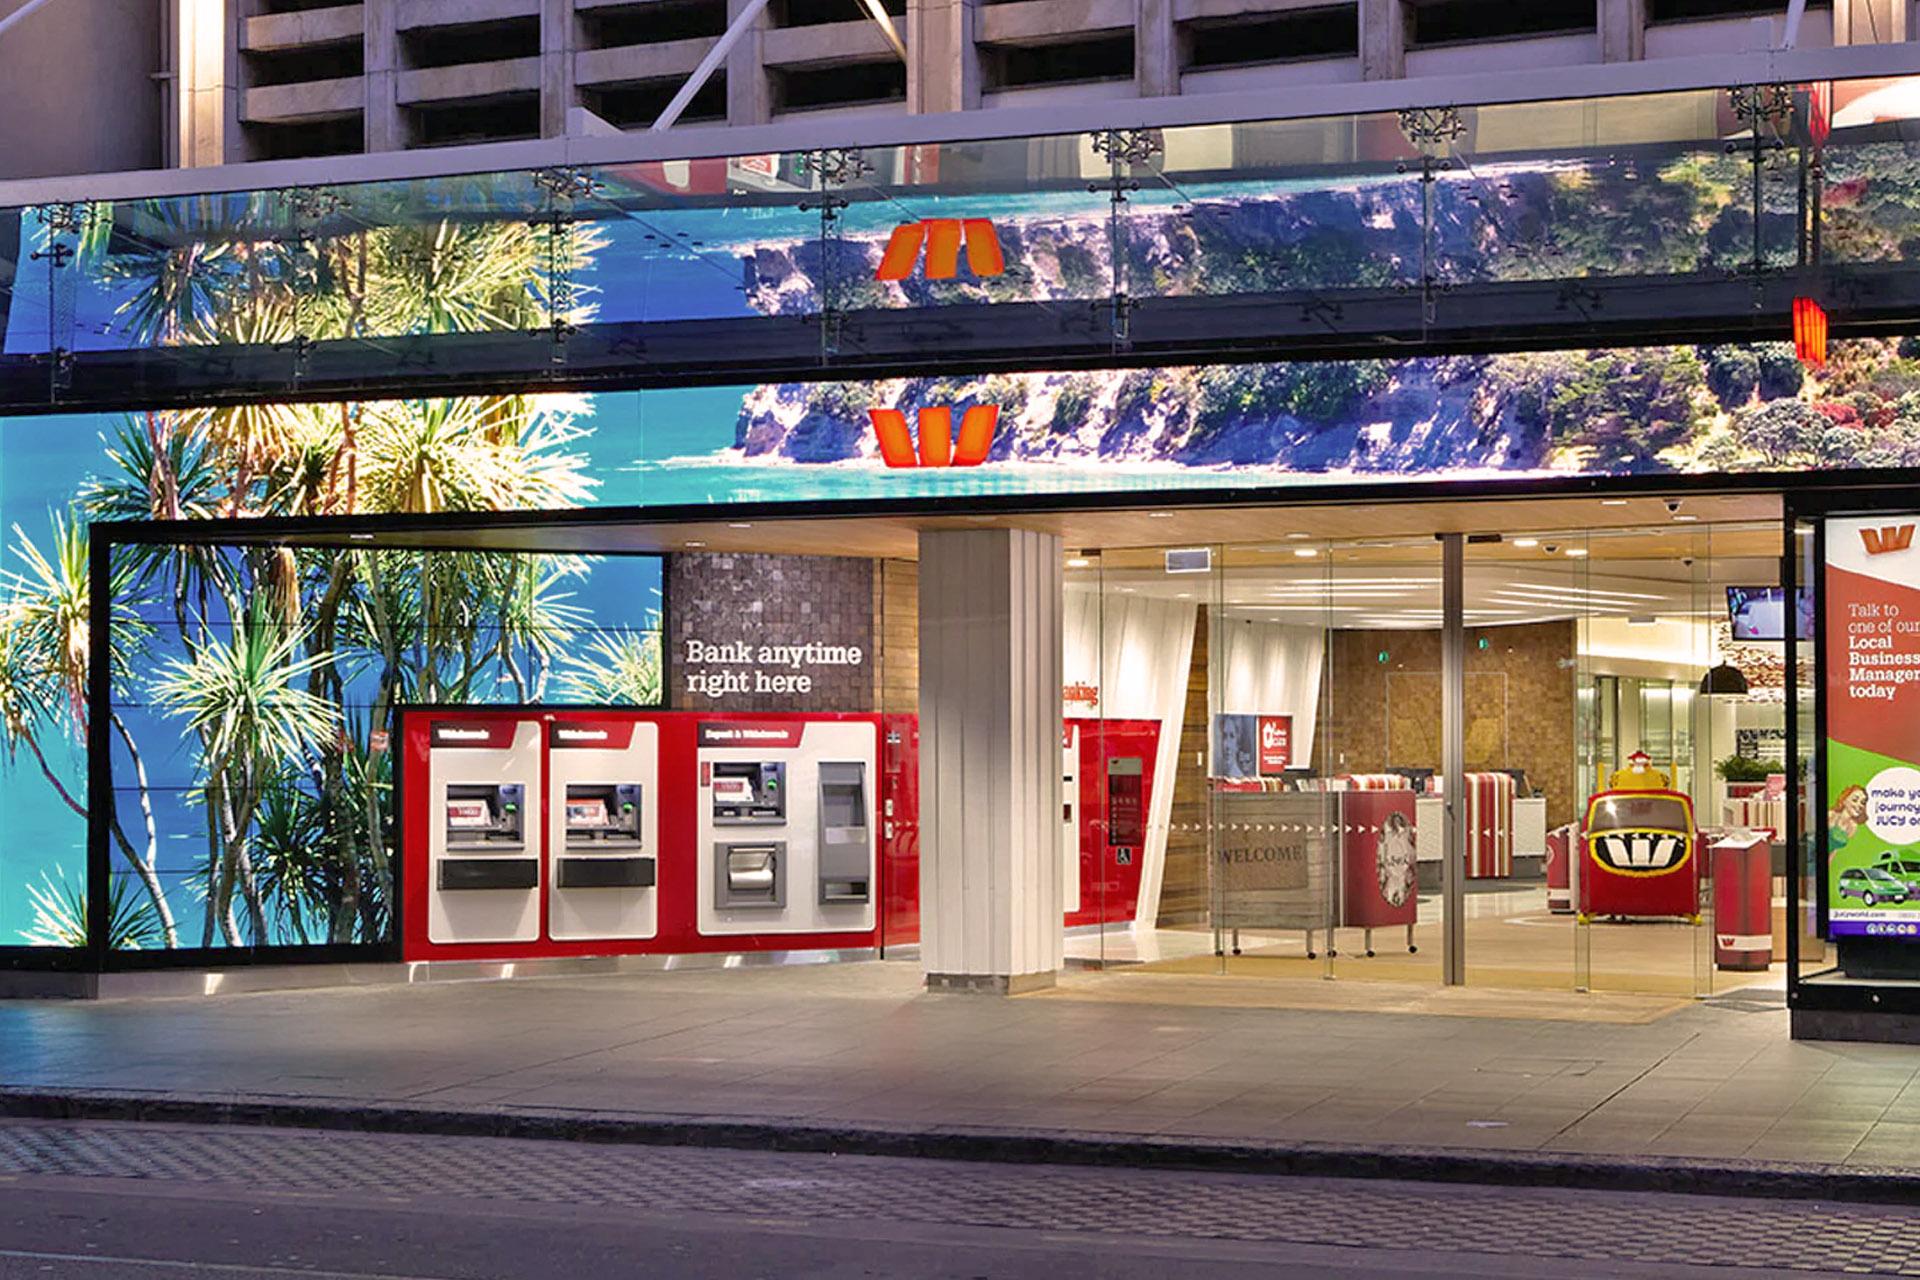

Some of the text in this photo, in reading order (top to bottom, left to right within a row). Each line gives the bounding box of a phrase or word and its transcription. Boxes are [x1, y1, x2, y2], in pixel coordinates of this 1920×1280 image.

[1848, 604, 1899, 617] Talk to
[1848, 619, 1920, 634] one of our
[1849, 635, 1892, 649] Local
[686, 640, 862, 669] Bank anytime
[1849, 651, 1920, 666] Business
[1849, 667, 1920, 684] Manager
[687, 670, 812, 698] right here
[1849, 684, 1897, 700] today
[1063, 681, 1099, 706] anking
[1871, 788, 1905, 798] make
[1217, 845, 1303, 863] WELCOME
